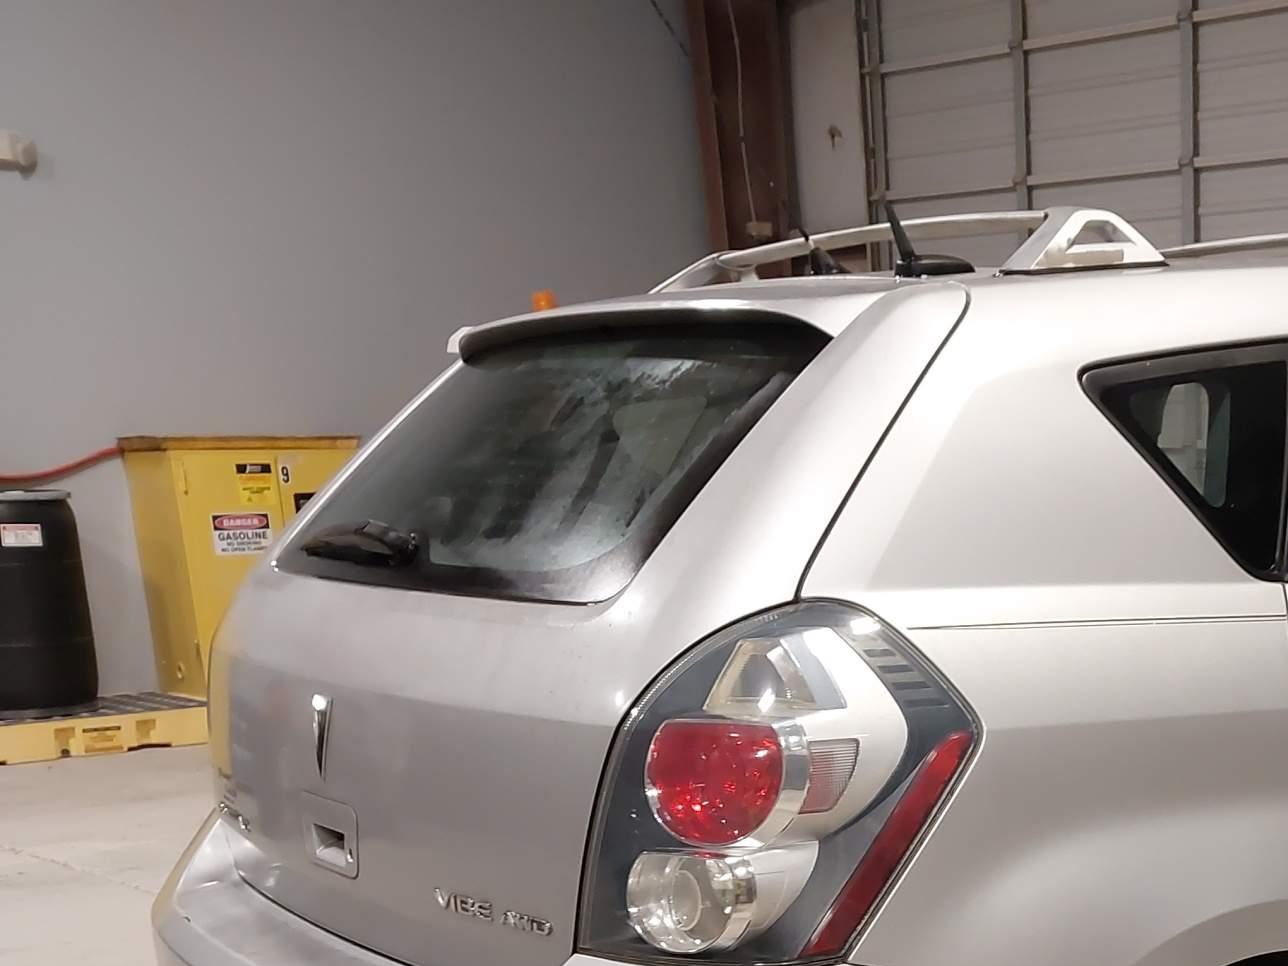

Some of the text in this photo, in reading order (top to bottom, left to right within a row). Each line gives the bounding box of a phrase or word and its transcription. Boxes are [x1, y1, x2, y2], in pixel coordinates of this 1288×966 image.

[281, 466, 290, 483] 9
[222, 518, 260, 526] DANGER
[217, 530, 268, 541] GASOLINE
[434, 888, 554, 936] VIBE AWD
